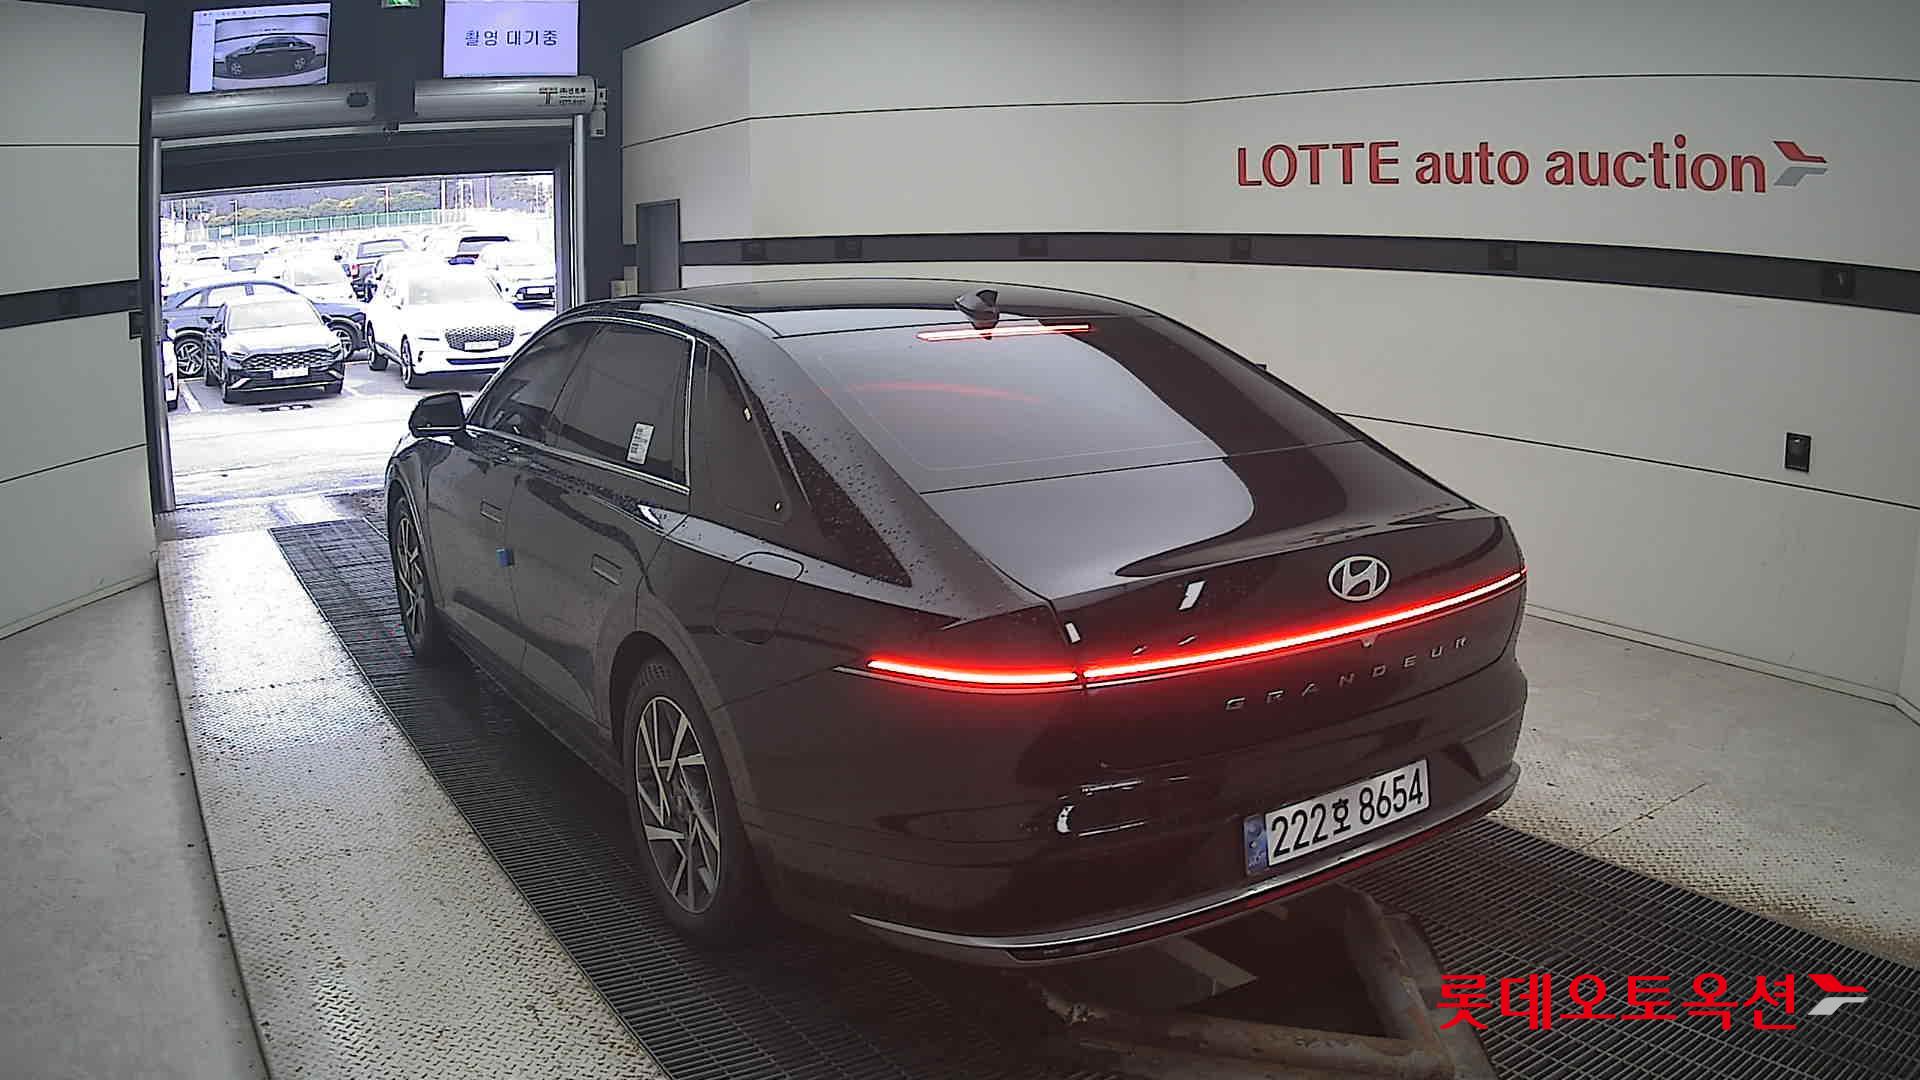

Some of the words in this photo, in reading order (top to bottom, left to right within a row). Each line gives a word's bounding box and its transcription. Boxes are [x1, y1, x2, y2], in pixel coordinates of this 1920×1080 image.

[506, 29, 558, 46] 대기중
[1237, 141, 1399, 187] LOTTE
[1415, 142, 1529, 185] auto
[1545, 134, 1767, 193] auction
[1224, 636, 1468, 711] GRANDEUR
[1271, 798, 1351, 858] 222호
[1359, 767, 1424, 825] 8654
